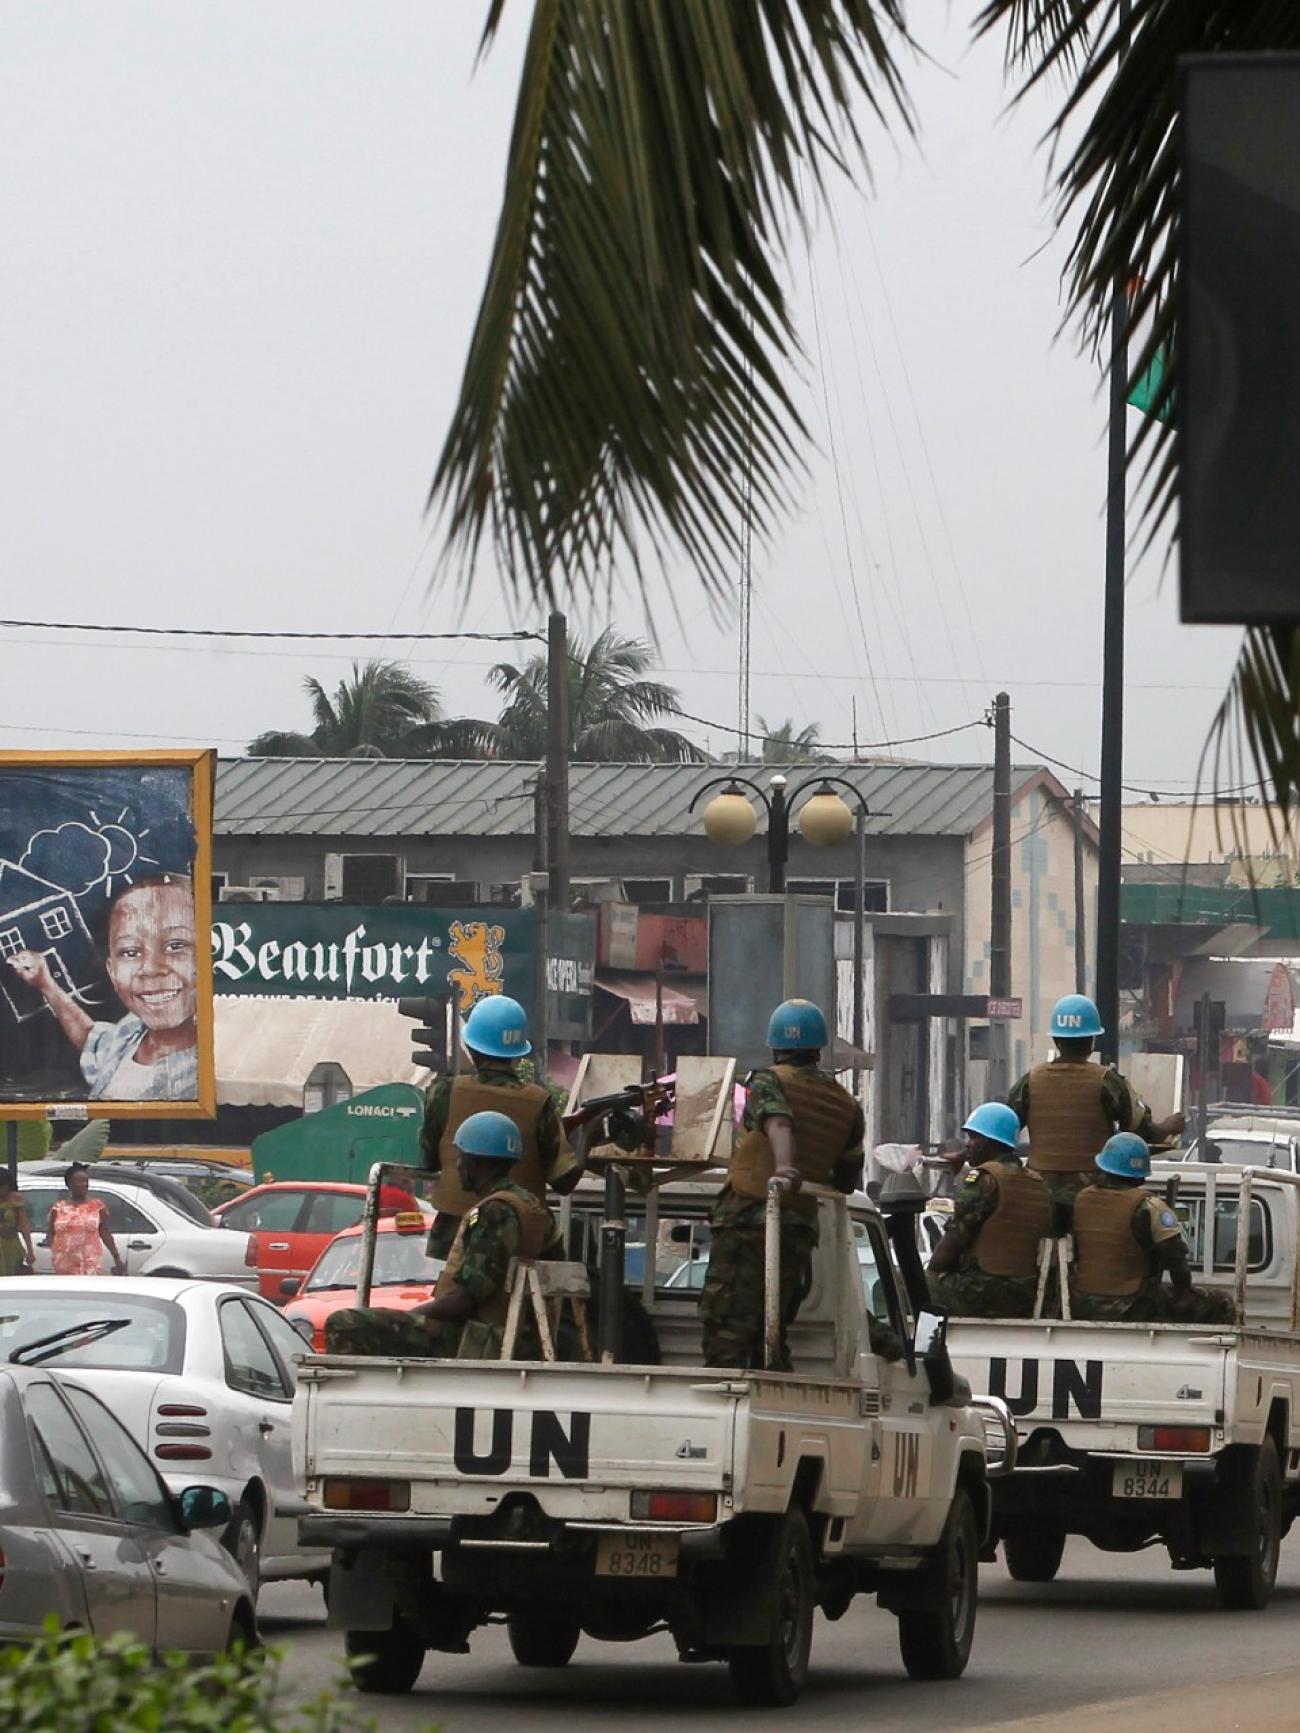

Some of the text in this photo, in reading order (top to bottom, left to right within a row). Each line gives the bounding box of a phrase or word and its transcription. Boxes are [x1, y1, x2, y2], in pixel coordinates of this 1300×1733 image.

[211, 922, 433, 994] Beaufort
[1056, 1014, 1082, 1027] UN
[347, 1105, 394, 1117] LONACI
[989, 1358, 1103, 1419] UN
[453, 1407, 591, 1479] UN
[1137, 1461, 1160, 1477] UN
[1124, 1478, 1169, 1496] 8344
[609, 1552, 661, 1574] 8348
